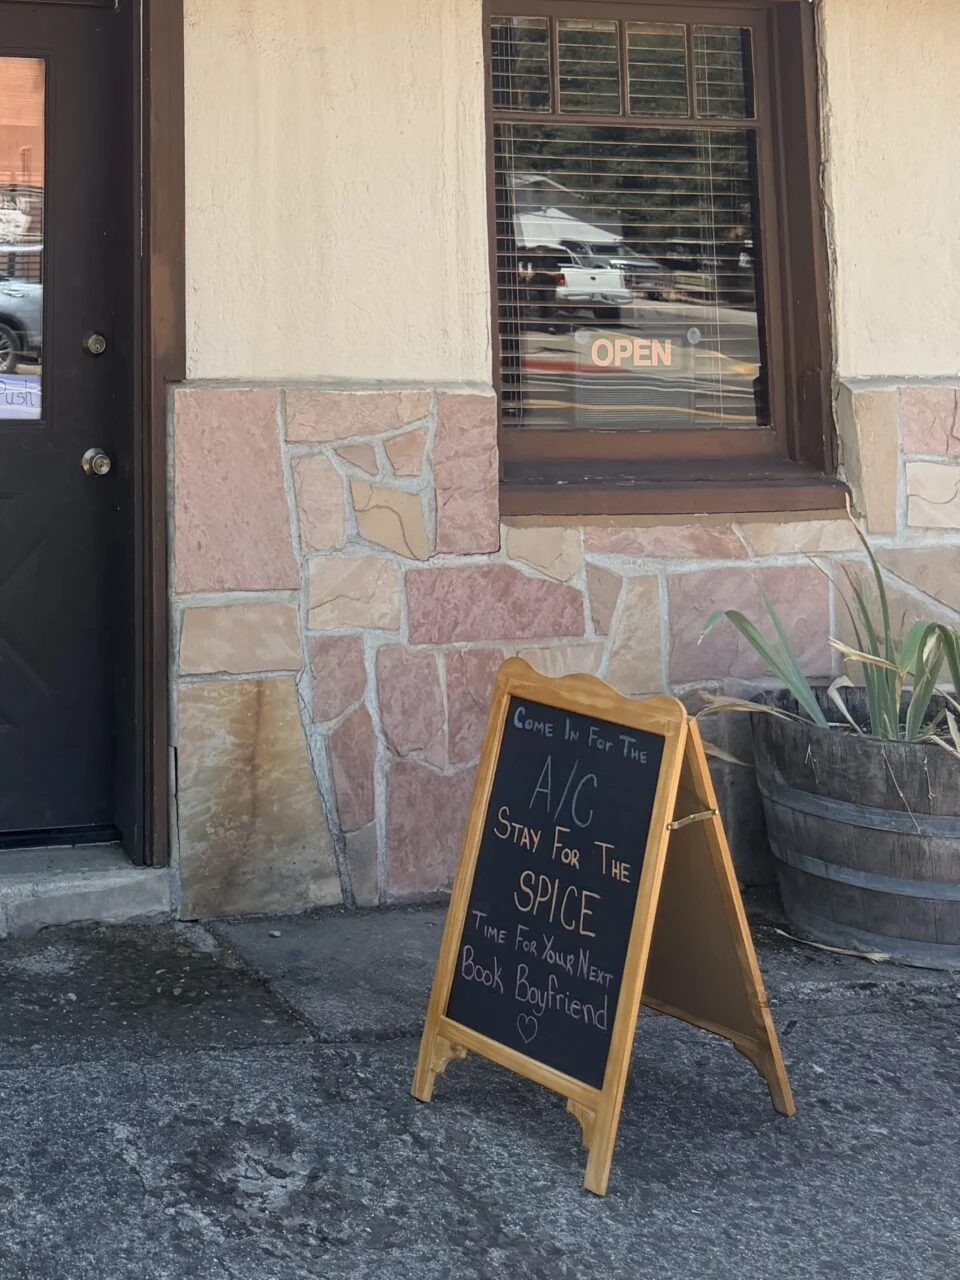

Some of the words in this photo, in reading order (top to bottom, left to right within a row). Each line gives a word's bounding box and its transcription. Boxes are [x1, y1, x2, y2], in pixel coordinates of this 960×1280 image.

[590, 338, 672, 367] OPEN
[529, 755, 598, 828] A/C
[514, 870, 601, 938] SPICE
[461, 944, 504, 994] Book
[515, 964, 609, 1031] Boyfriend
